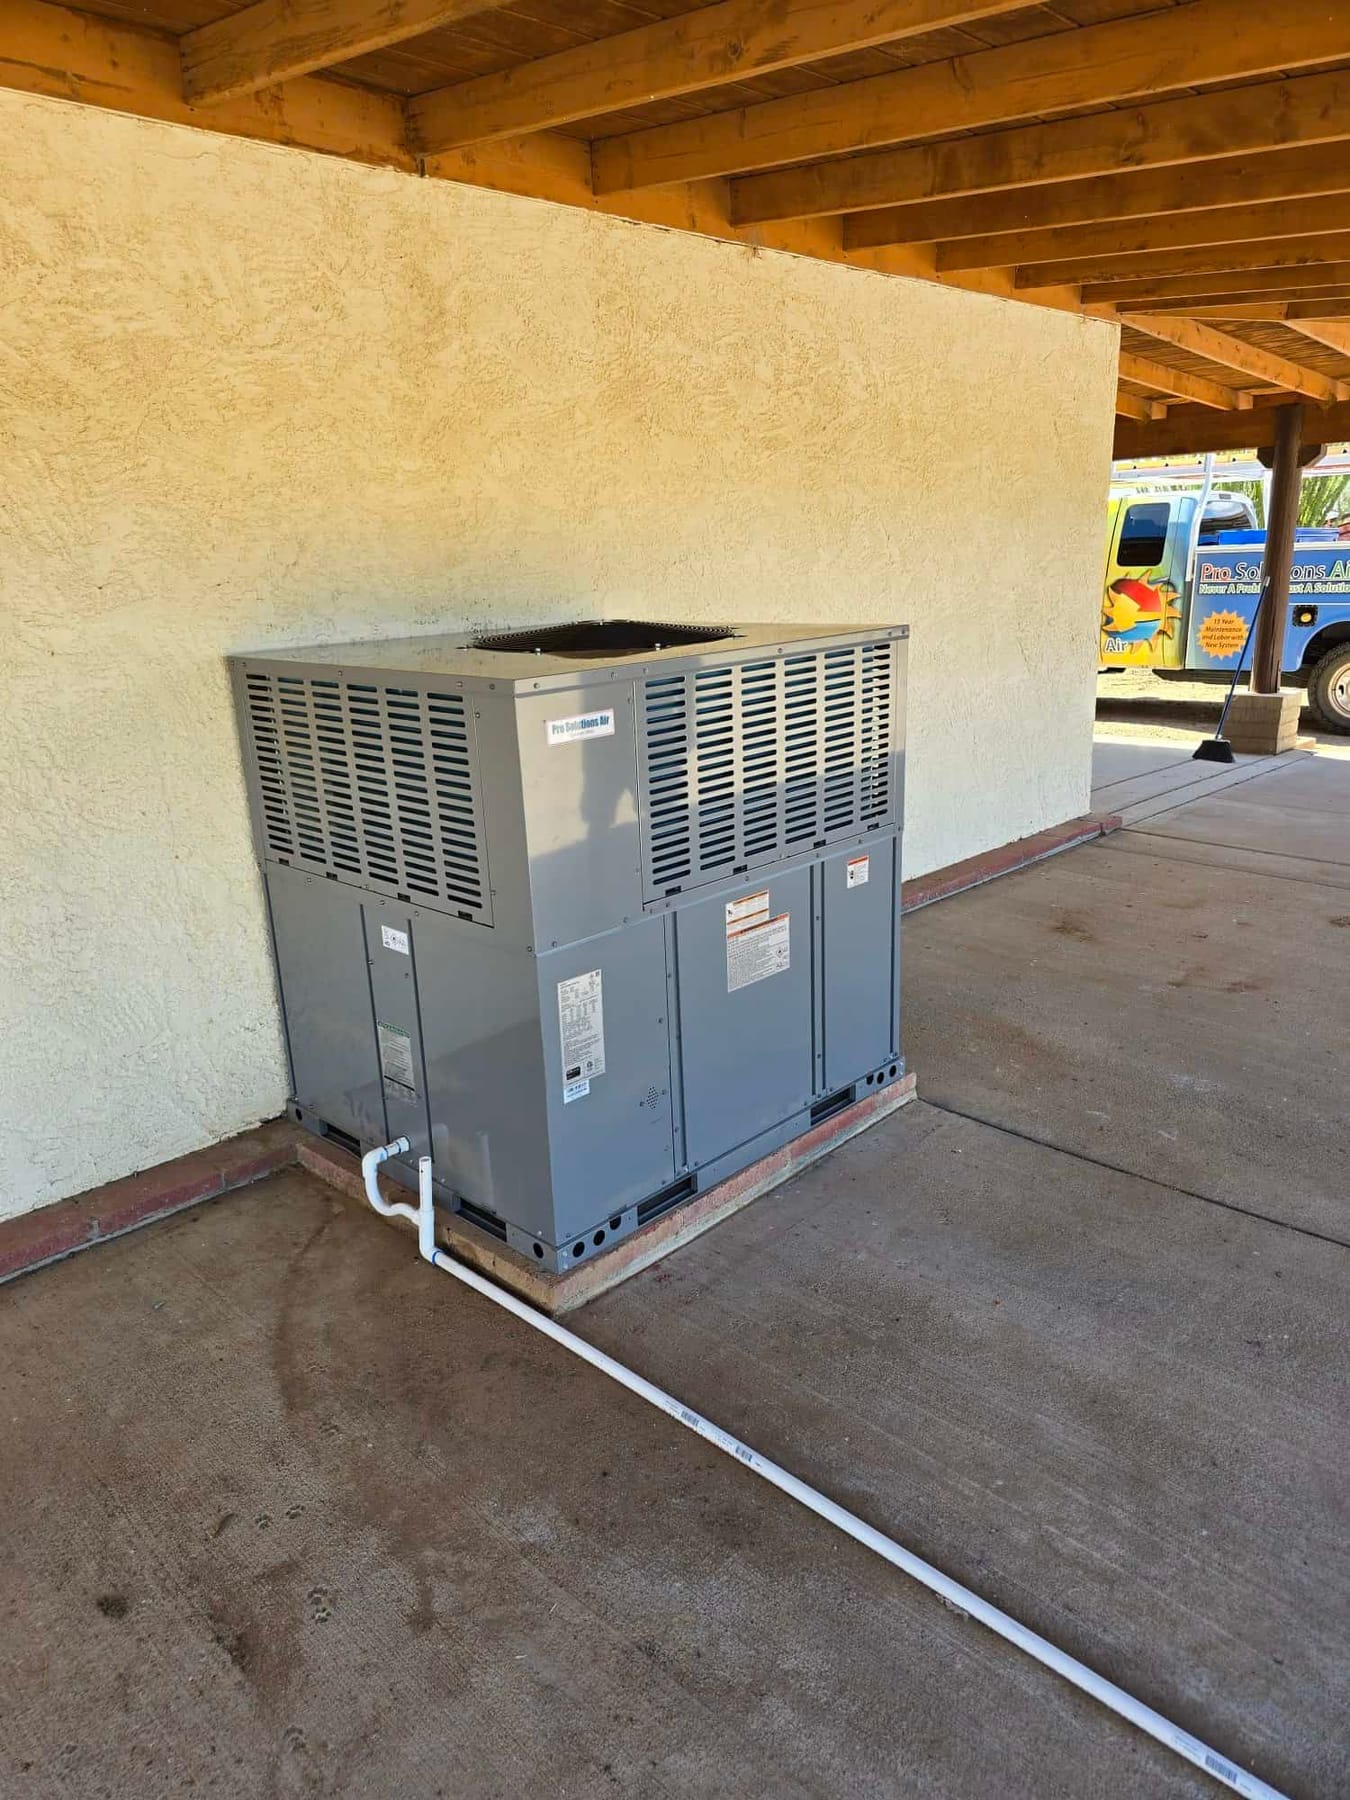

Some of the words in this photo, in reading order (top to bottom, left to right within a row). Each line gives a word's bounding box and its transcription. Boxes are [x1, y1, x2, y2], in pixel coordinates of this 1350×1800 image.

[1201, 562, 1232, 581] Pro
[1235, 561, 1326, 581] Solons
[1330, 559, 1350, 580] Ai
[1227, 583, 1236, 593] A
[1304, 582, 1313, 593] A
[1314, 582, 1350, 593] Solutio
[1104, 637, 1129, 653] Air
[552, 724, 564, 735] Pro
[565, 718, 599, 732] Solutions
[600, 715, 609, 725] Air
